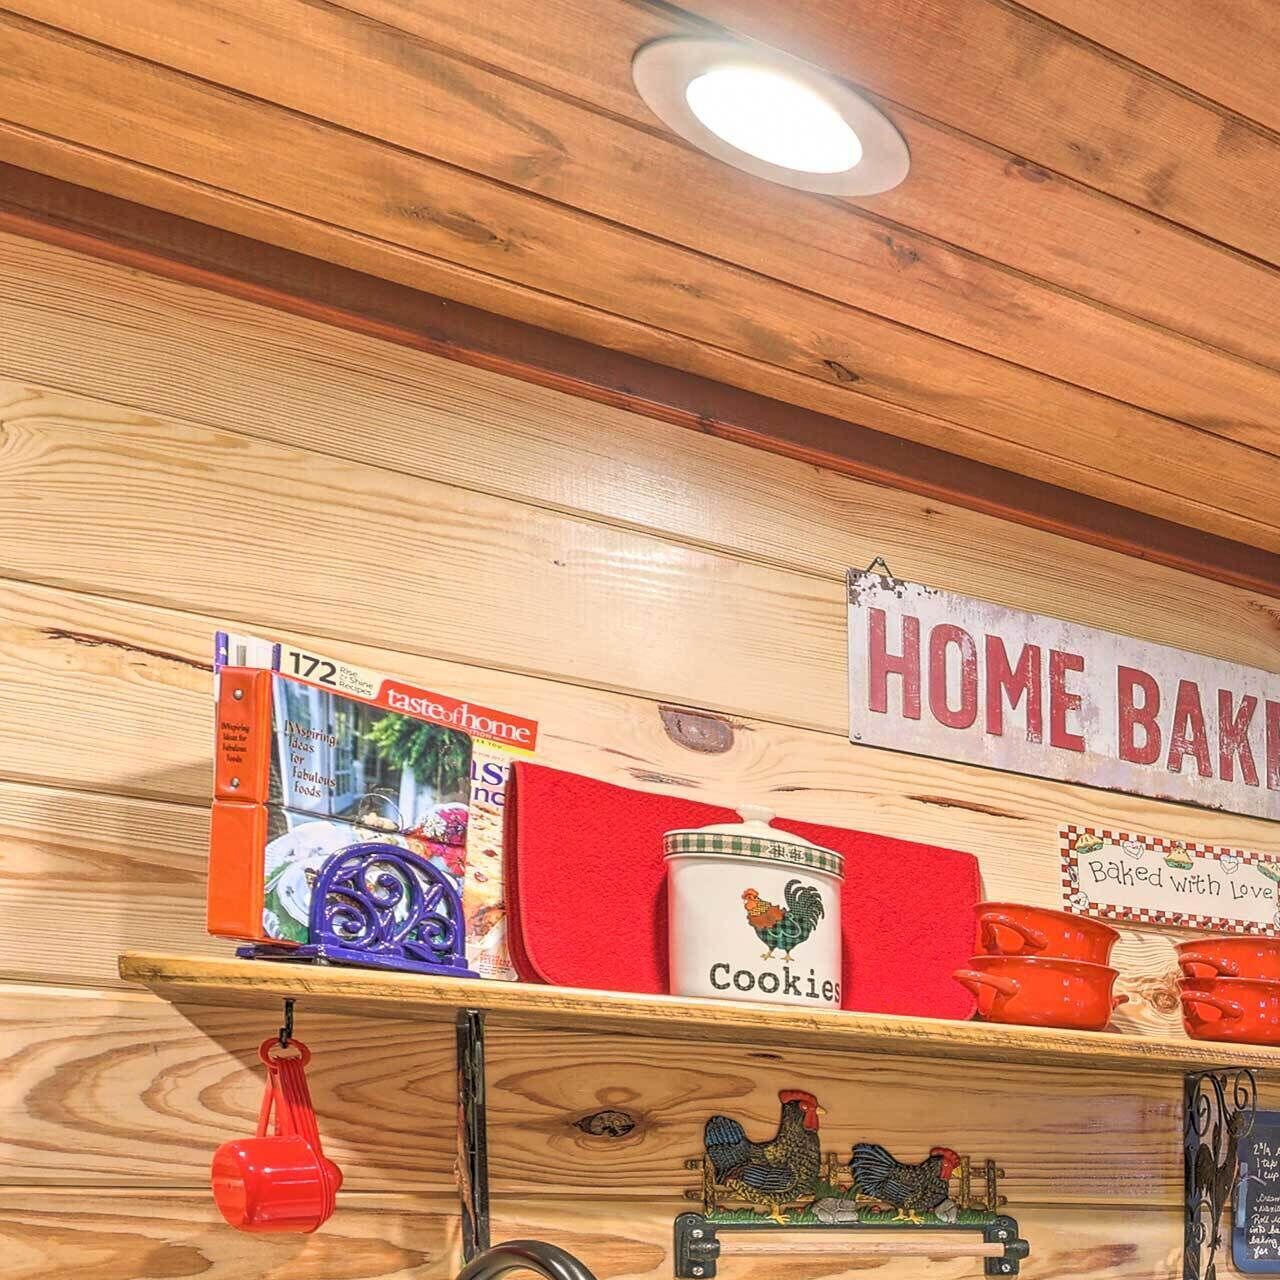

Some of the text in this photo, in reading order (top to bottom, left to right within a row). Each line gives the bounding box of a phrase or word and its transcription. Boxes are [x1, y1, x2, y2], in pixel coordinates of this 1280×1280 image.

[290, 651, 337, 686] 172
[339, 681, 372, 697] Recipes
[868, 608, 1086, 753] HOME
[288, 736, 316, 753] Ideas
[290, 752, 304, 765] for
[292, 767, 337, 787] Fabulous
[294, 781, 321, 799] Foods
[1088, 860, 1273, 900] Baked with Love
[709, 962, 841, 1003] Cookies
